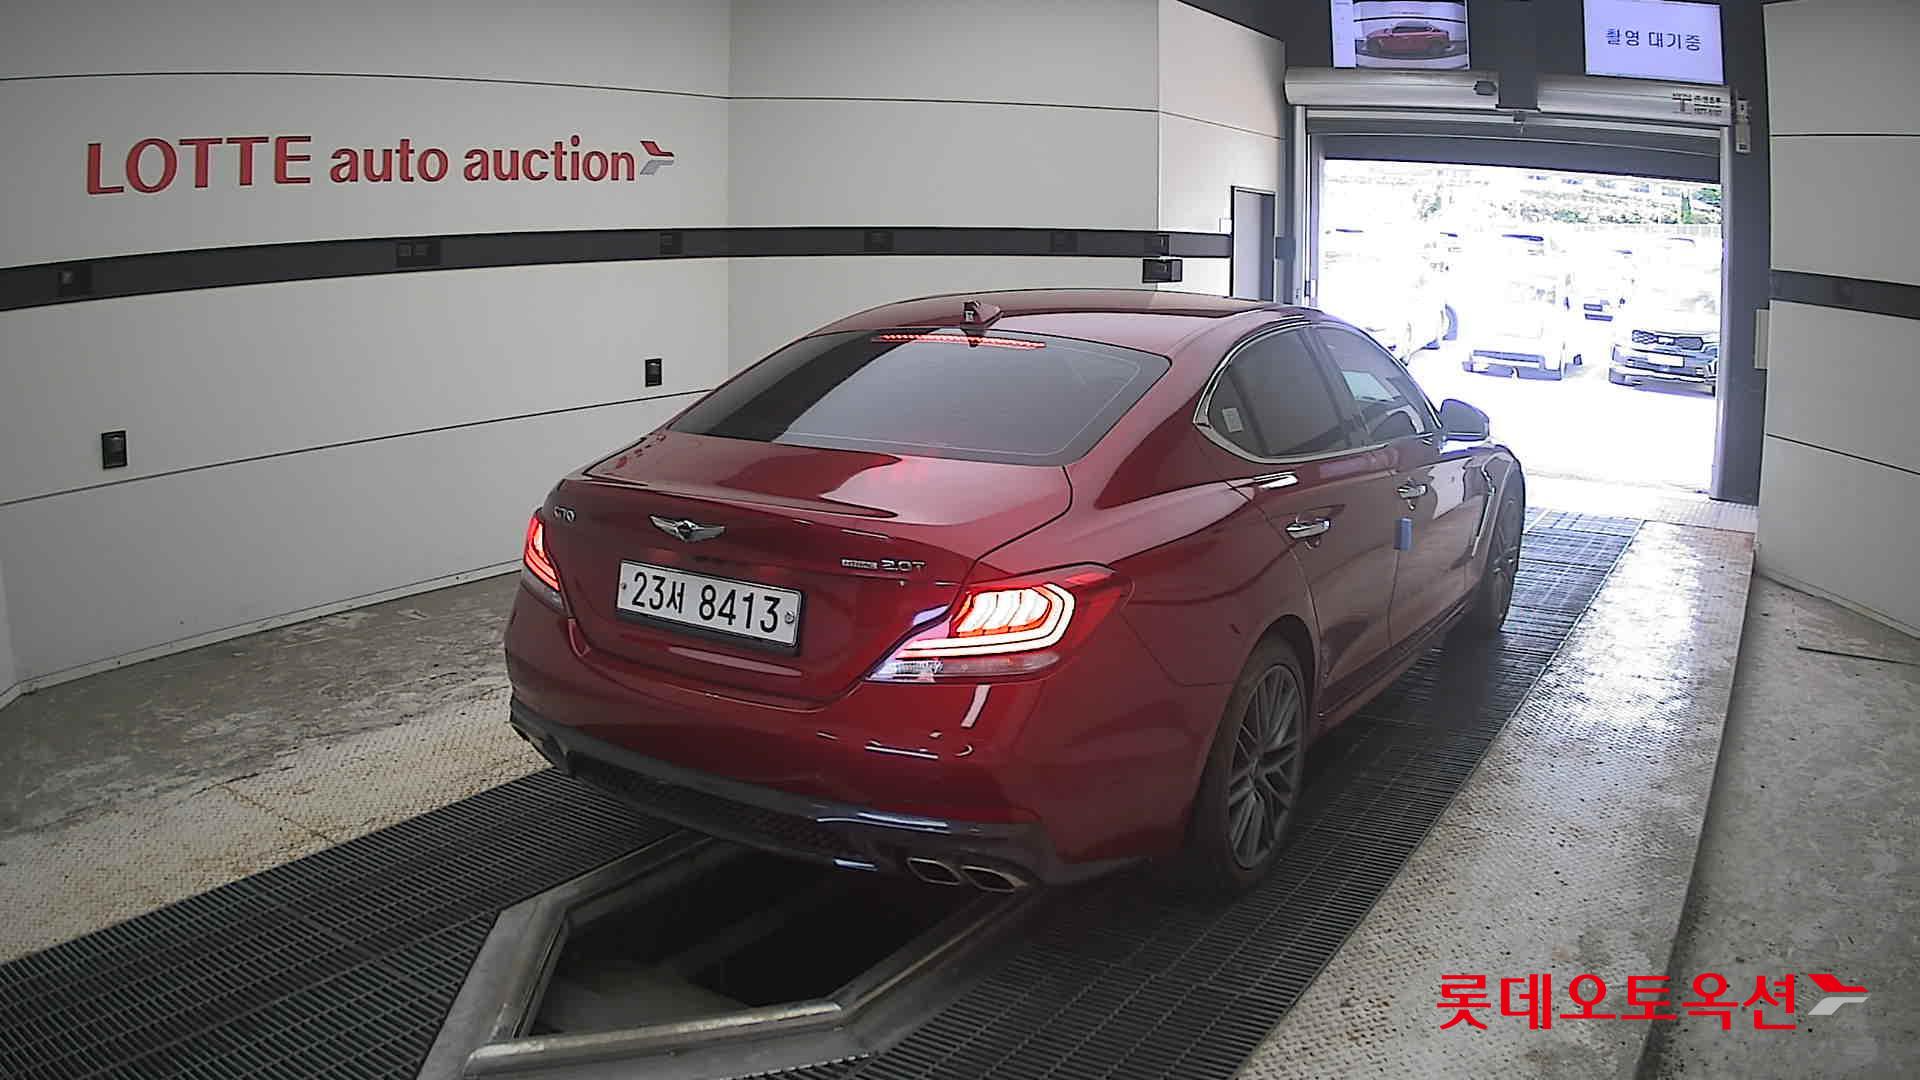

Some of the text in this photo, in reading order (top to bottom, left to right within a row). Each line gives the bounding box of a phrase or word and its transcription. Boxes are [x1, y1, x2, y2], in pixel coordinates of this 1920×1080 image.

[1648, 31, 1702, 52] 대기중
[87, 135, 636, 195] LOTTE auto auction
[631, 571, 781, 633] 23서 8413
